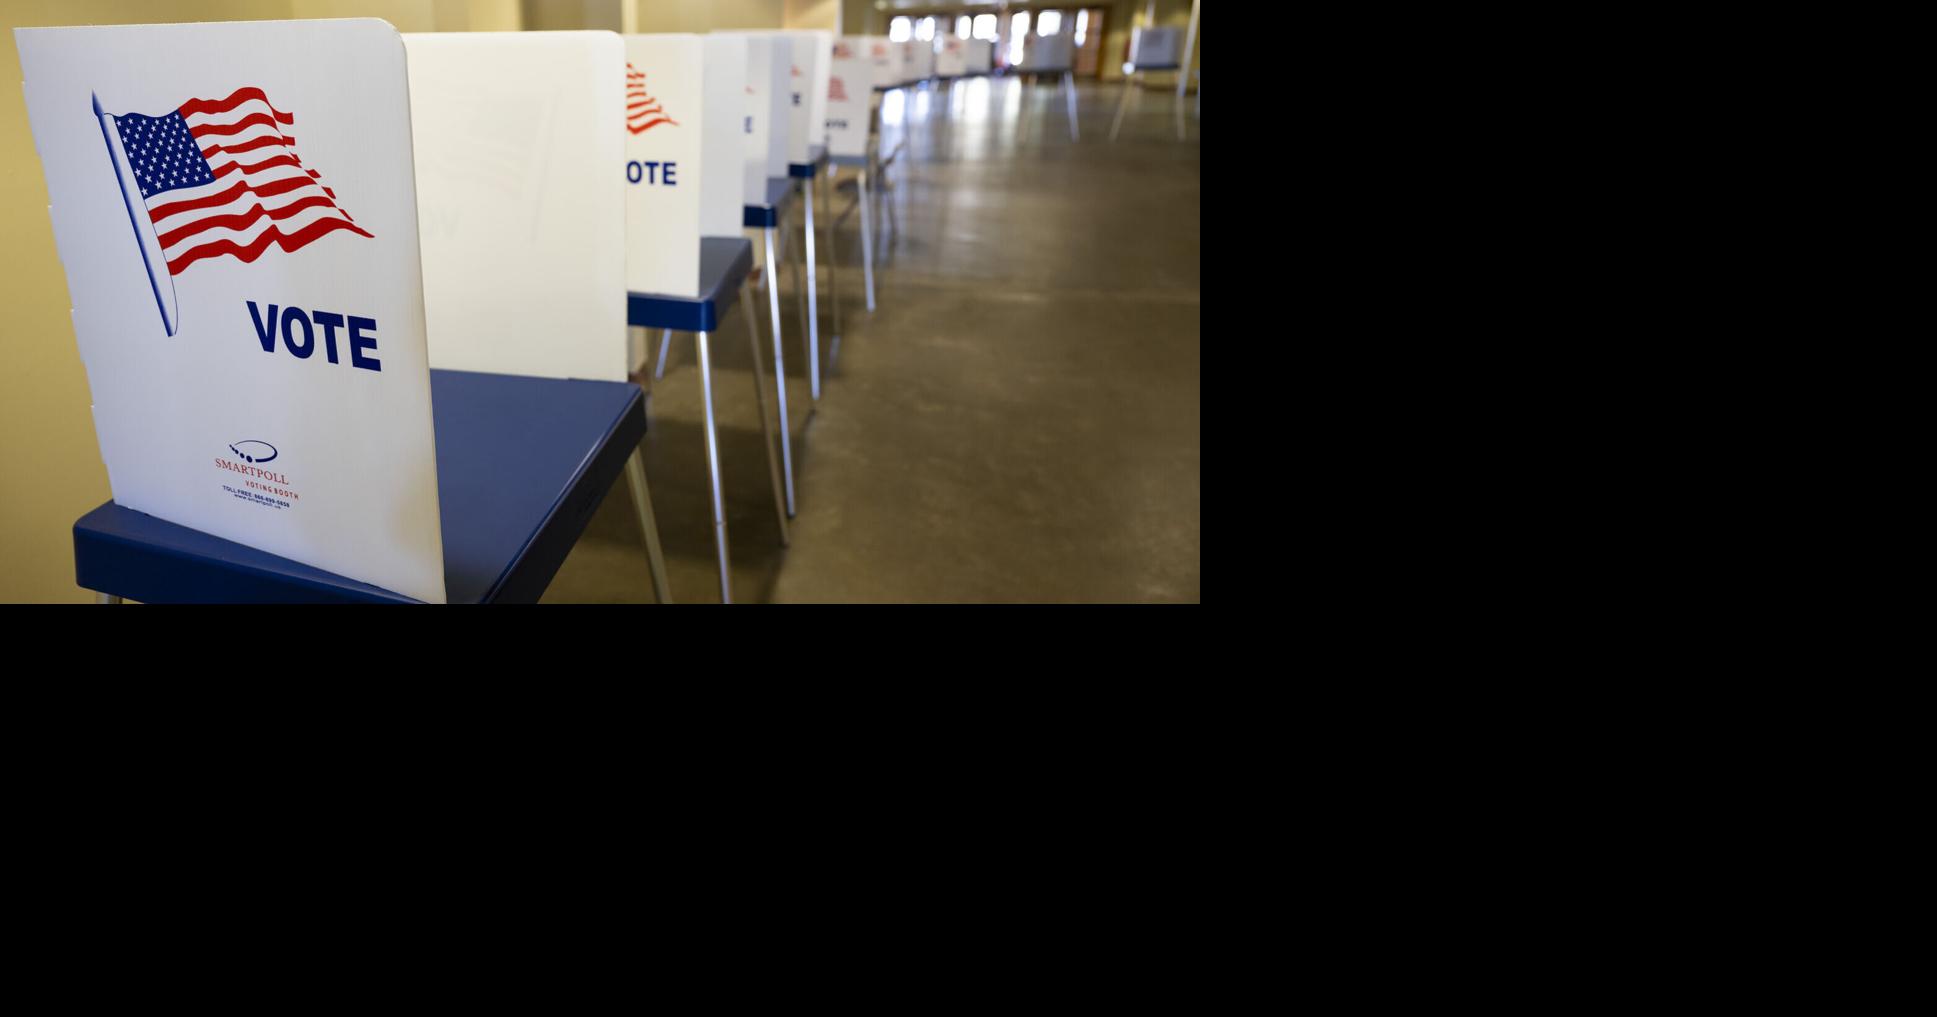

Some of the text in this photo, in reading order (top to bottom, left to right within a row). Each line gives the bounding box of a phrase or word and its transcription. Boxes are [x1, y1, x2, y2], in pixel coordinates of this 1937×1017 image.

[626, 160, 677, 185] OTE
[246, 300, 381, 371] VOTE
[215, 458, 289, 485] SMARTPOLL
[245, 480, 299, 500] VOTING BOOTH
